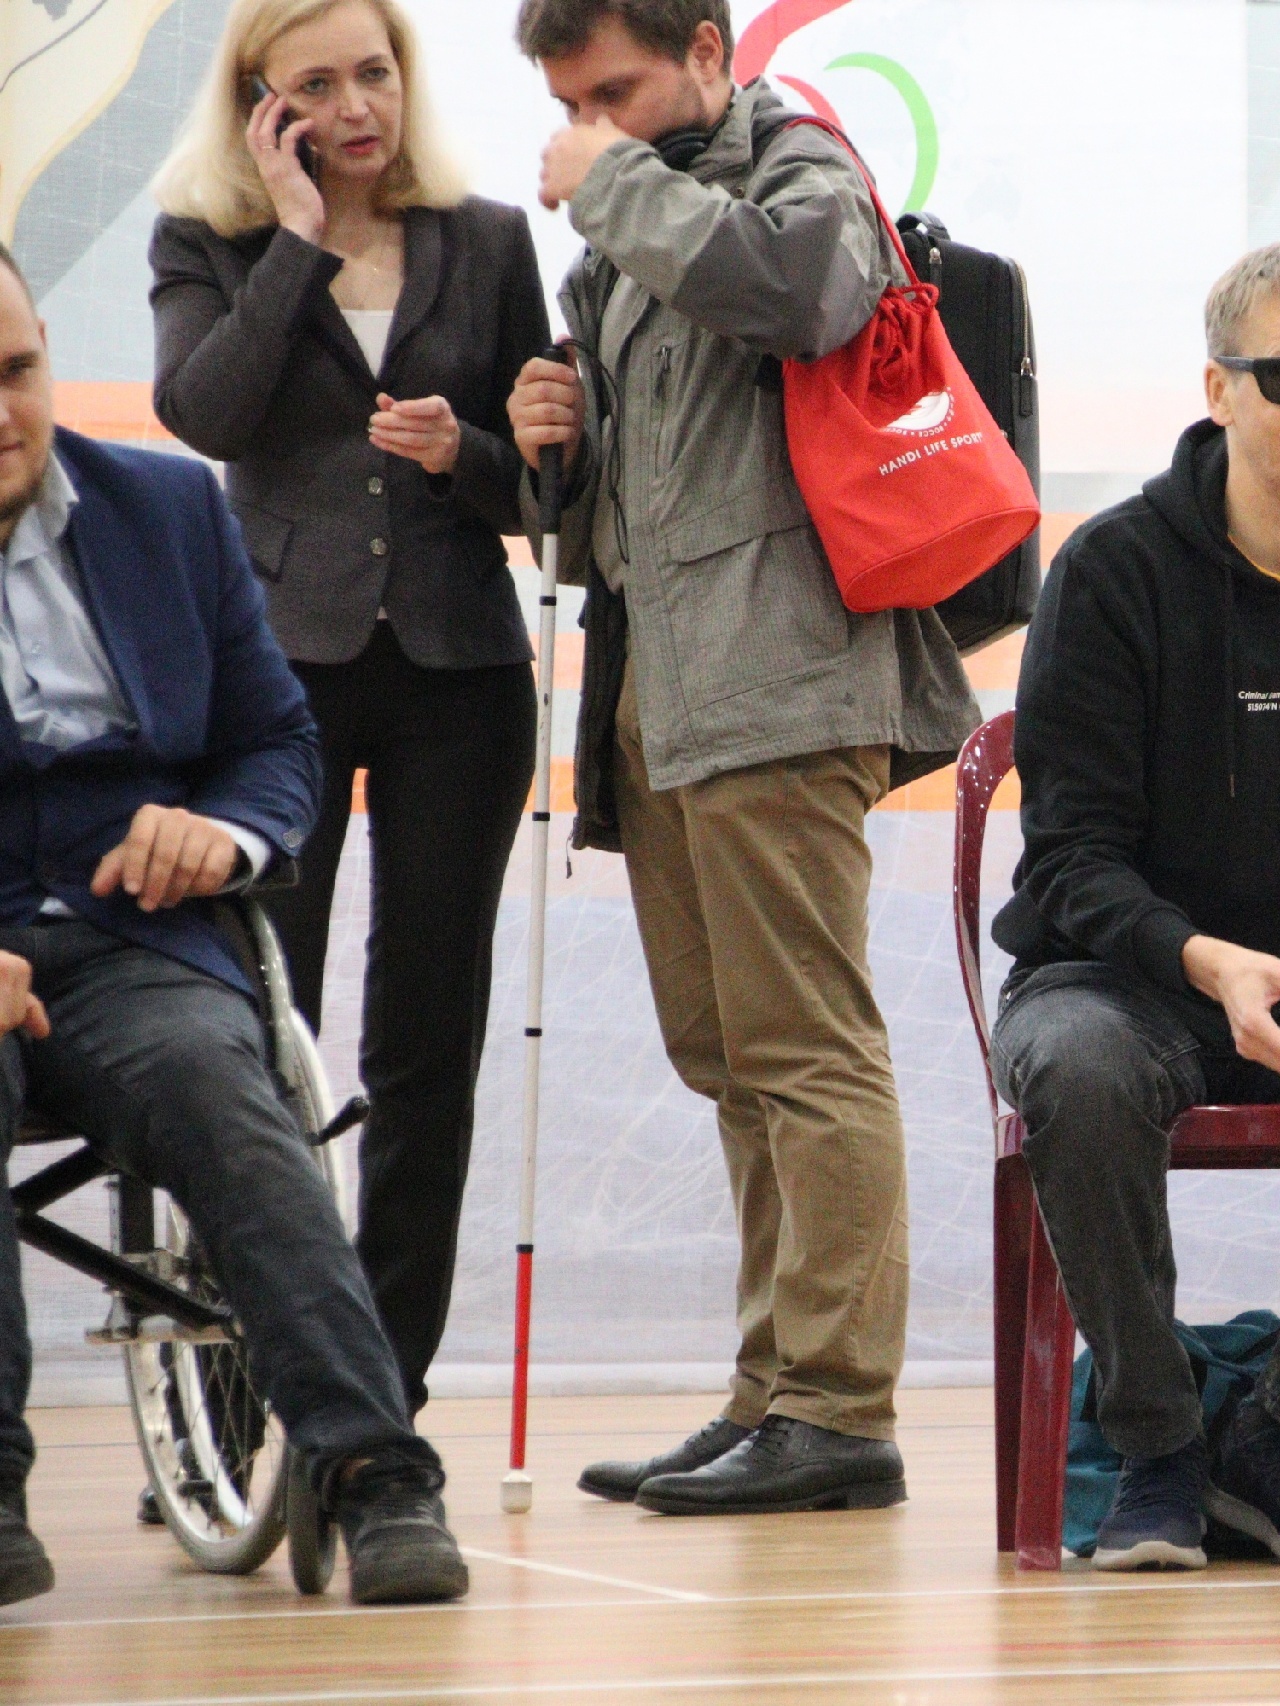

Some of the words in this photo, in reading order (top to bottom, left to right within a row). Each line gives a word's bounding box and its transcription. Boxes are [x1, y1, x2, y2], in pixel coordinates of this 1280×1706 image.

[878, 449, 921, 476] HANDI
[923, 439, 949, 458] LIFE
[950, 431, 983, 449] SPORT
